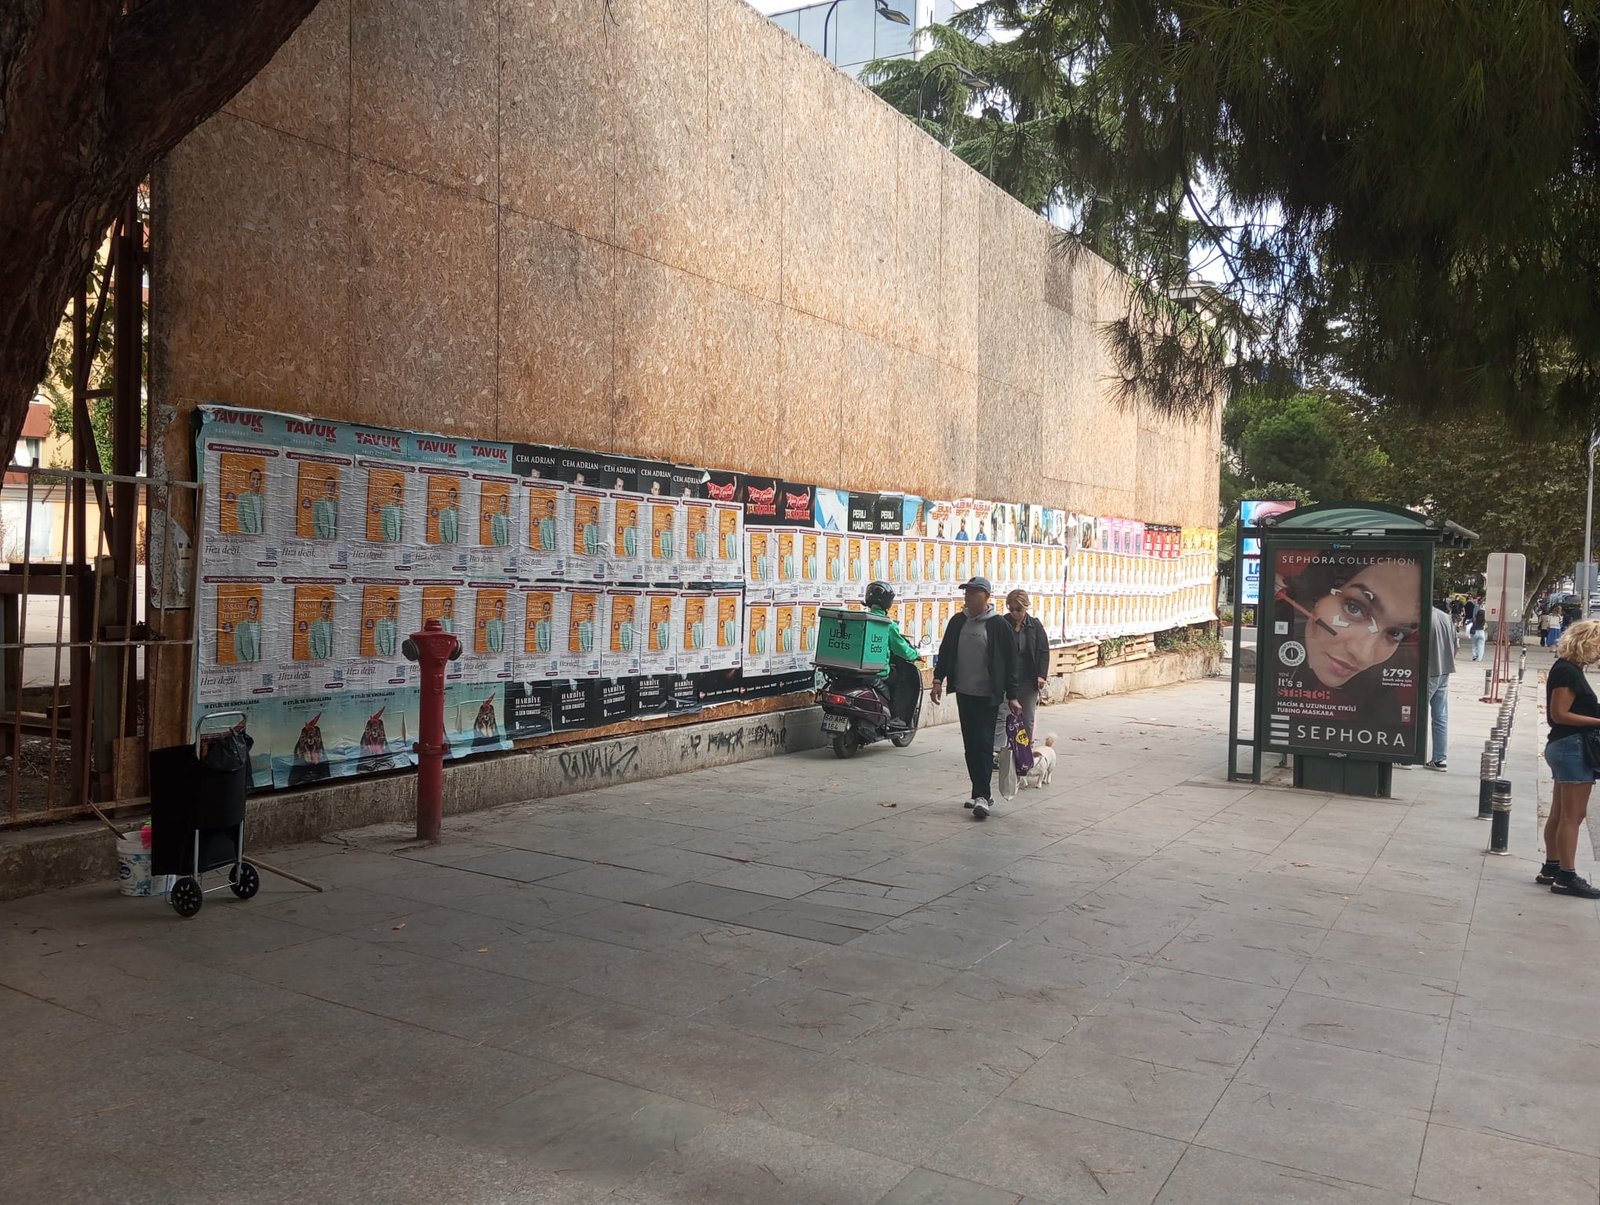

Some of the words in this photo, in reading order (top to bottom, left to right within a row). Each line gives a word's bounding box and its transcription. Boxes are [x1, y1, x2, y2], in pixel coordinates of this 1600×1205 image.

[213, 409, 263, 428] TAVUK
[285, 420, 337, 438] TAVUK
[355, 432, 401, 448] TAVUK
[417, 440, 457, 454] TAVUK
[471, 445, 507, 460] TAVUK
[516, 454, 529, 463] CEM
[531, 456, 556, 465] ADRIAN
[562, 459, 575, 468] CEM
[576, 461, 599, 470] ADRIAN
[604, 464, 615, 473] CEM
[616, 466, 636, 475] ADRIAN
[641, 469, 651, 477] CEM
[653, 470, 671, 478] ADRIAN
[673, 475, 683, 483] CEM
[852, 521, 873, 530] HAUNTED
[880, 521, 900, 530] HAUNTED
[1282, 555, 1335, 564] SEPHORA
[1338, 556, 1415, 566] COLLECTION
[829, 628, 852, 640] Uber
[871, 633, 884, 643] Uber
[828, 639, 851, 650] Eats
[870, 644, 882, 653] Eats
[1382, 668, 1412, 678] ₺799
[1278, 678, 1293, 688] It's
[1302, 709, 1334, 717] MASKARA
[1306, 703, 1337, 711] UZUNLUK
[1337, 704, 1356, 712] ETKİLİ
[1297, 725, 1405, 747] SEPHORA
